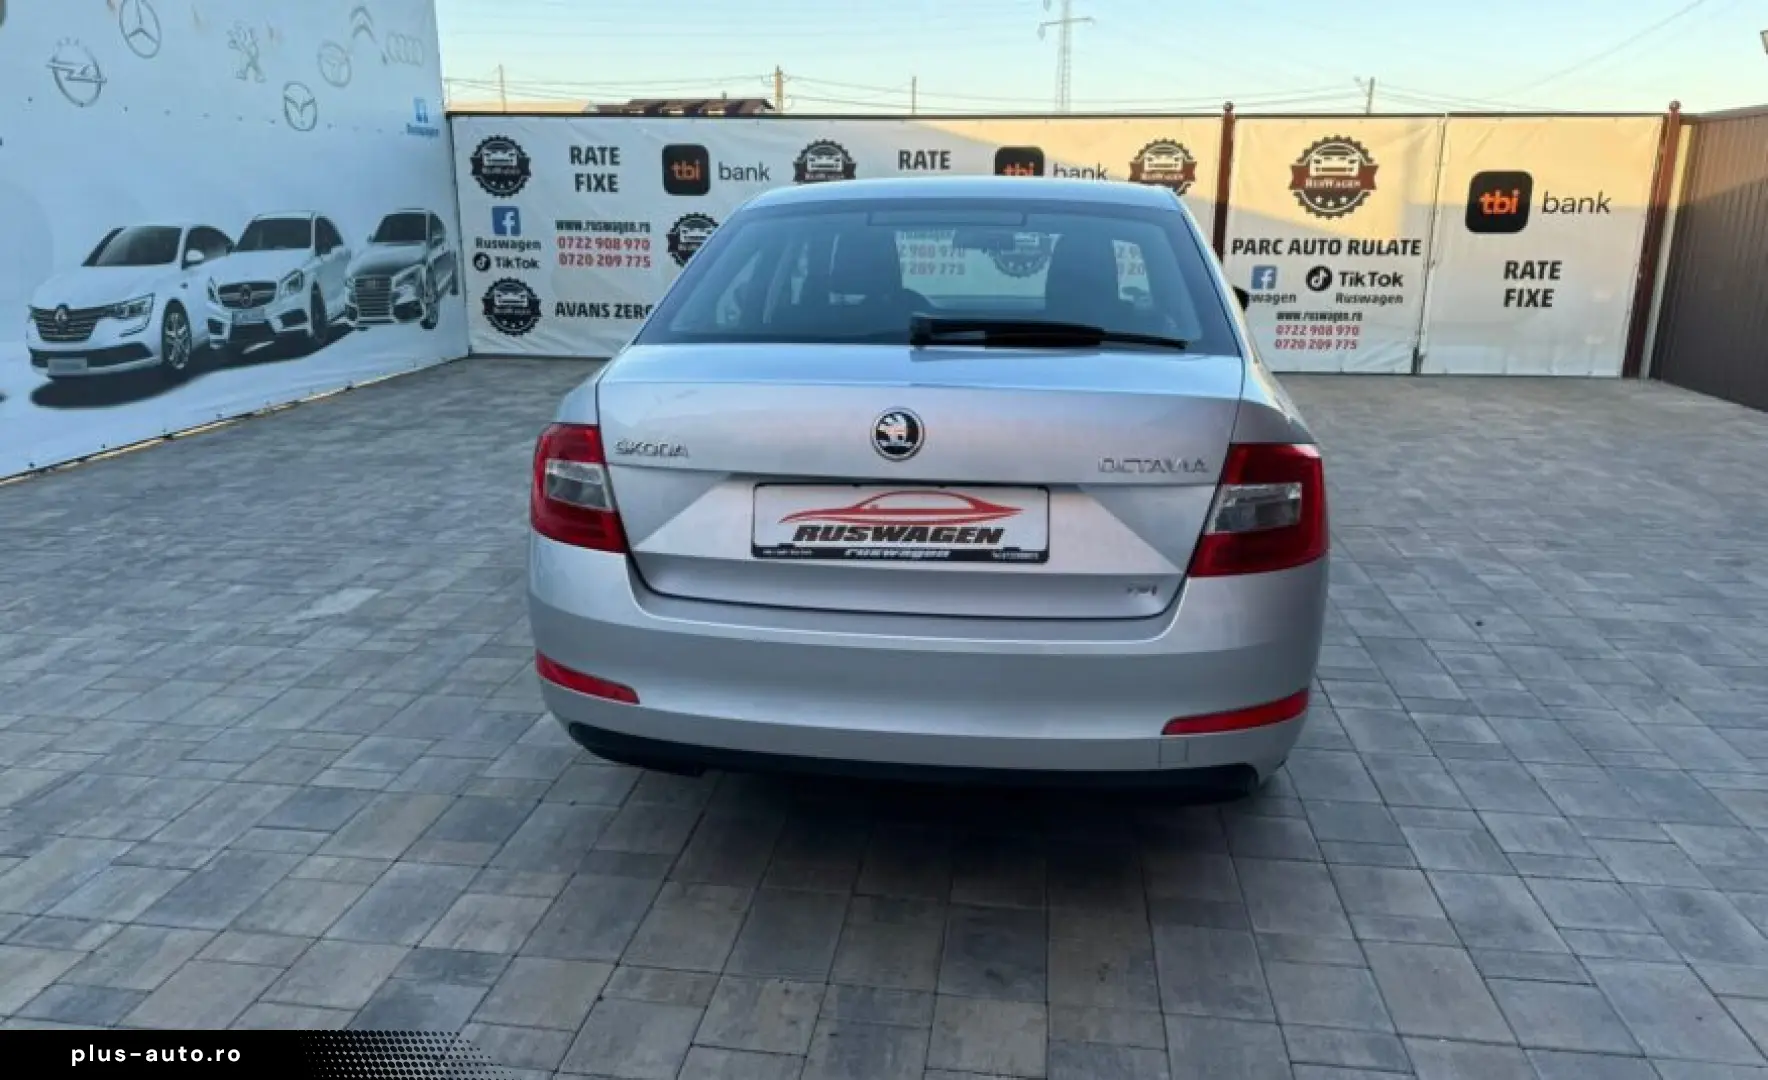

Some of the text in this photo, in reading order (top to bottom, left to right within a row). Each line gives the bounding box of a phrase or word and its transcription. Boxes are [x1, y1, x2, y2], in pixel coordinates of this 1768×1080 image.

[570, 145, 620, 166] RATE
[899, 150, 951, 170] RATE
[671, 160, 771, 182] tbi bank
[574, 173, 619, 193] FIXE
[1480, 189, 1610, 214] tbi bank
[475, 237, 542, 251] Ruswagen
[557, 236, 592, 249] 0722
[623, 238, 651, 251] 970
[1231, 239, 1421, 256] PARC AUTO RULATE
[494, 256, 540, 269] TikTok
[559, 252, 651, 268] 0720 209 775
[1503, 259, 1562, 280] RATE
[1339, 271, 1404, 288] TikTok
[1335, 293, 1404, 306] Ruswagen
[1503, 288, 1555, 308] FIXE
[555, 302, 611, 318] AVANS
[1276, 325, 1307, 336] 0722
[1336, 325, 1360, 336] 970
[1275, 339, 1357, 350] 0720 209 775
[1098, 457, 1208, 474] OCTAVIA
[793, 524, 1004, 545] RUSWAGEN
